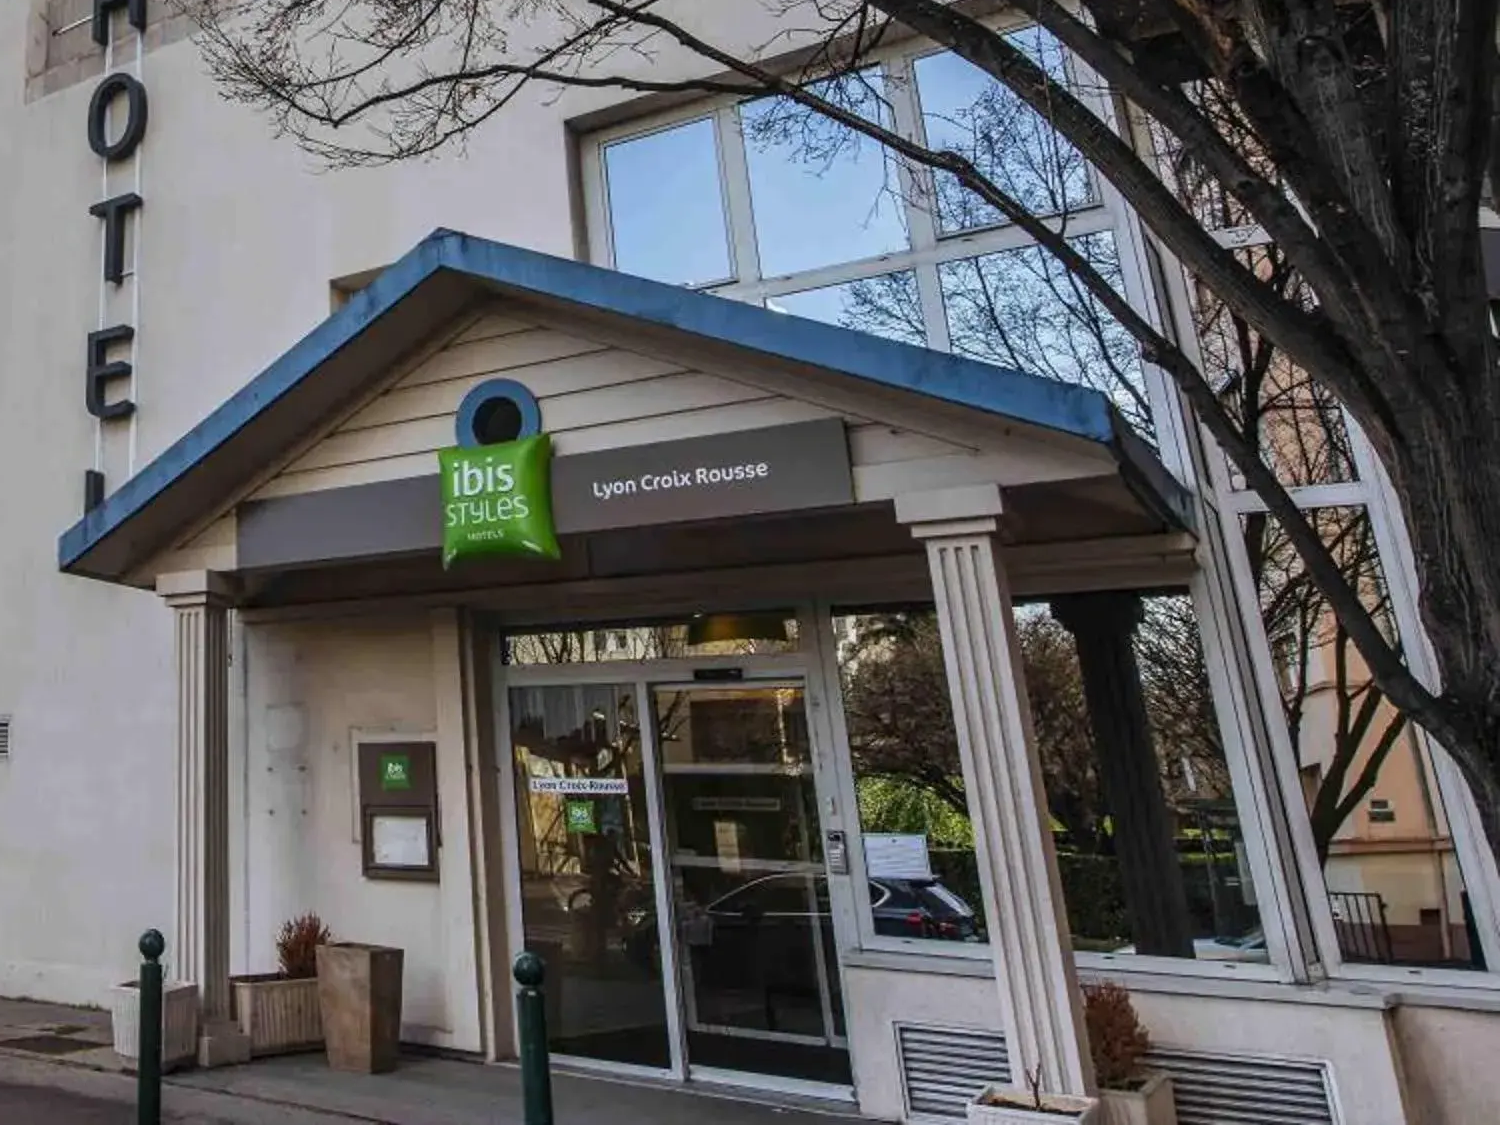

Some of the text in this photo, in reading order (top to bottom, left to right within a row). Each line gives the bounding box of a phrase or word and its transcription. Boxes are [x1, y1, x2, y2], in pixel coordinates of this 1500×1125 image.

[452, 456, 515, 497] ibis
[593, 462, 769, 500] Lyon Croix Rousse
